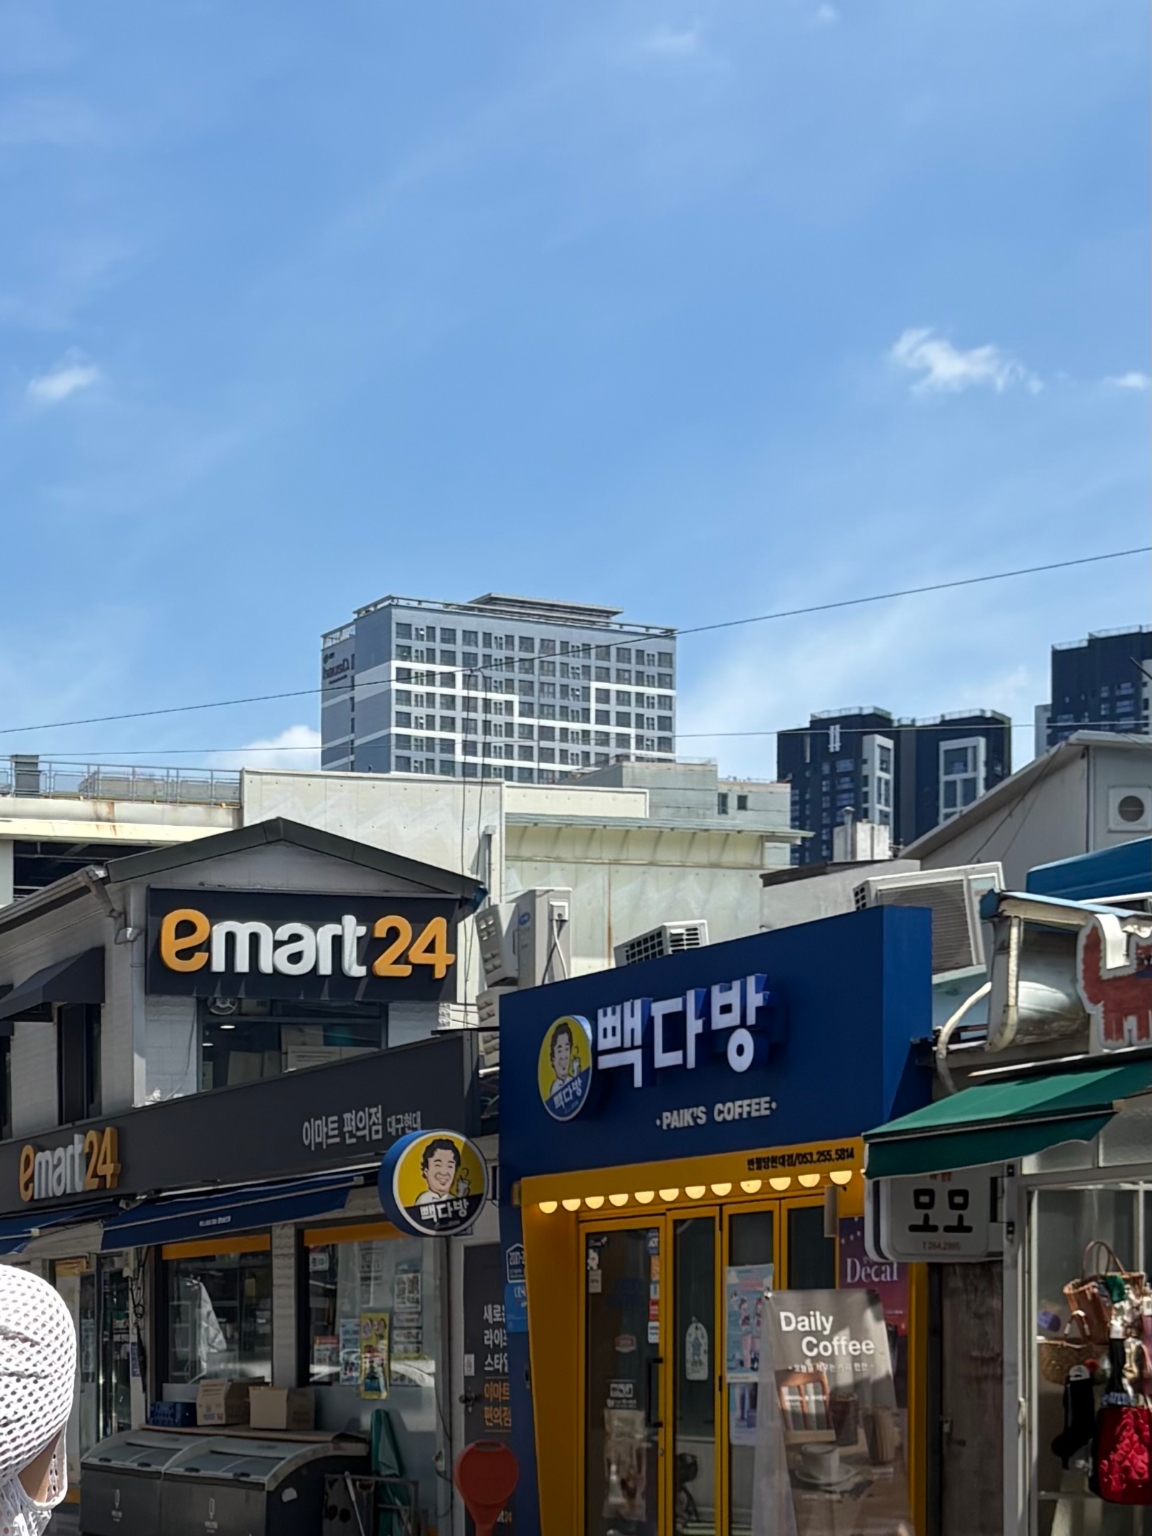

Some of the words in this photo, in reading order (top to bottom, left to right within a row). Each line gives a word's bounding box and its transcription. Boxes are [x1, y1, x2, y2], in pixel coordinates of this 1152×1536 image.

[160, 908, 456, 980] emart24
[598, 974, 770, 1088] 빽다방
[553, 1077, 583, 1110] 빽다방
[302, 1117, 341, 1151] 이마트
[343, 1105, 383, 1145] 편의점
[662, 1106, 707, 1130] PAIK'S
[714, 1097, 771, 1123] COFFEE
[19, 1126, 122, 1202] emart24
[419, 1198, 470, 1223] 빽다방
[908, 1187, 974, 1234] 모모
[779, 1311, 834, 1335] Daily
[801, 1336, 875, 1357] Coffee
[484, 1382, 510, 1402] 이마트
[484, 1407, 512, 1427] 편의점
